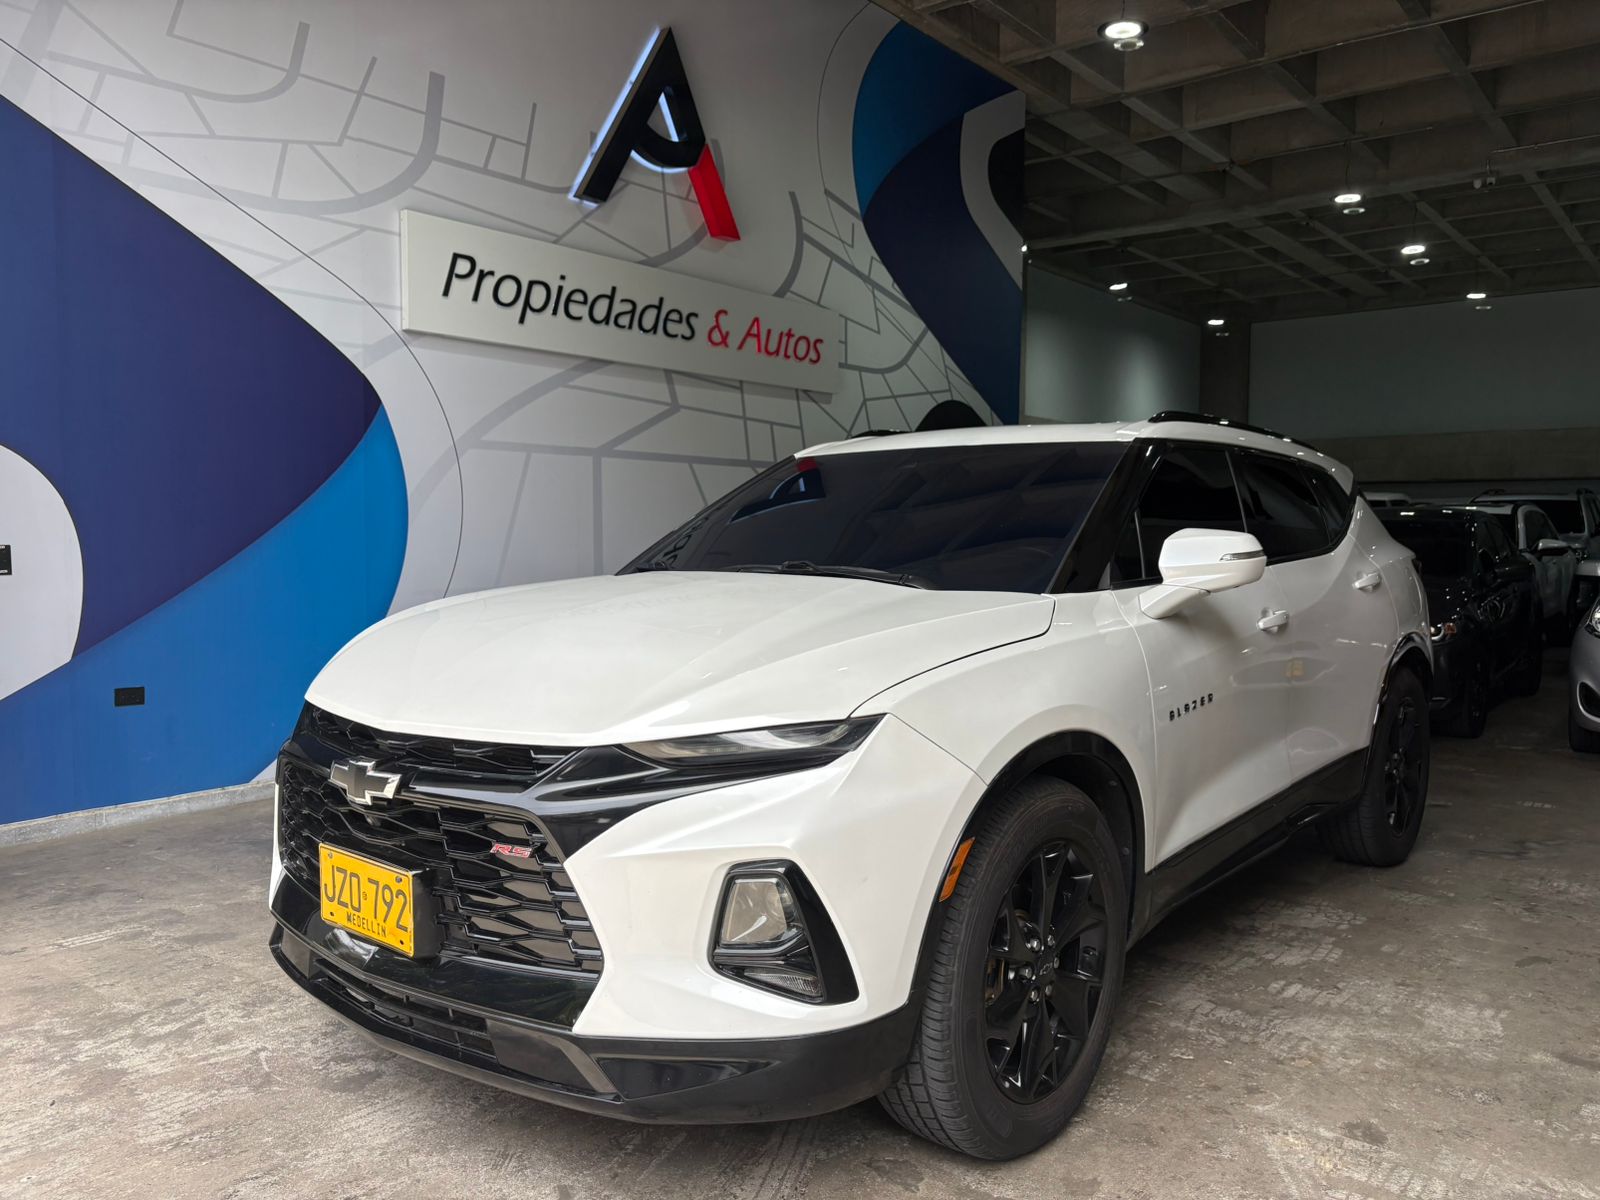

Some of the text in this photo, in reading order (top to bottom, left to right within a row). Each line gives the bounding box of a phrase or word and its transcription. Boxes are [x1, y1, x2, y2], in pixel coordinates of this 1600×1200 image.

[441, 252, 825, 365] Propiedades & Autos
[490, 843, 531, 859] RS
[346, 911, 387, 938] MEDELLIN
[368, 877, 408, 932] 792
